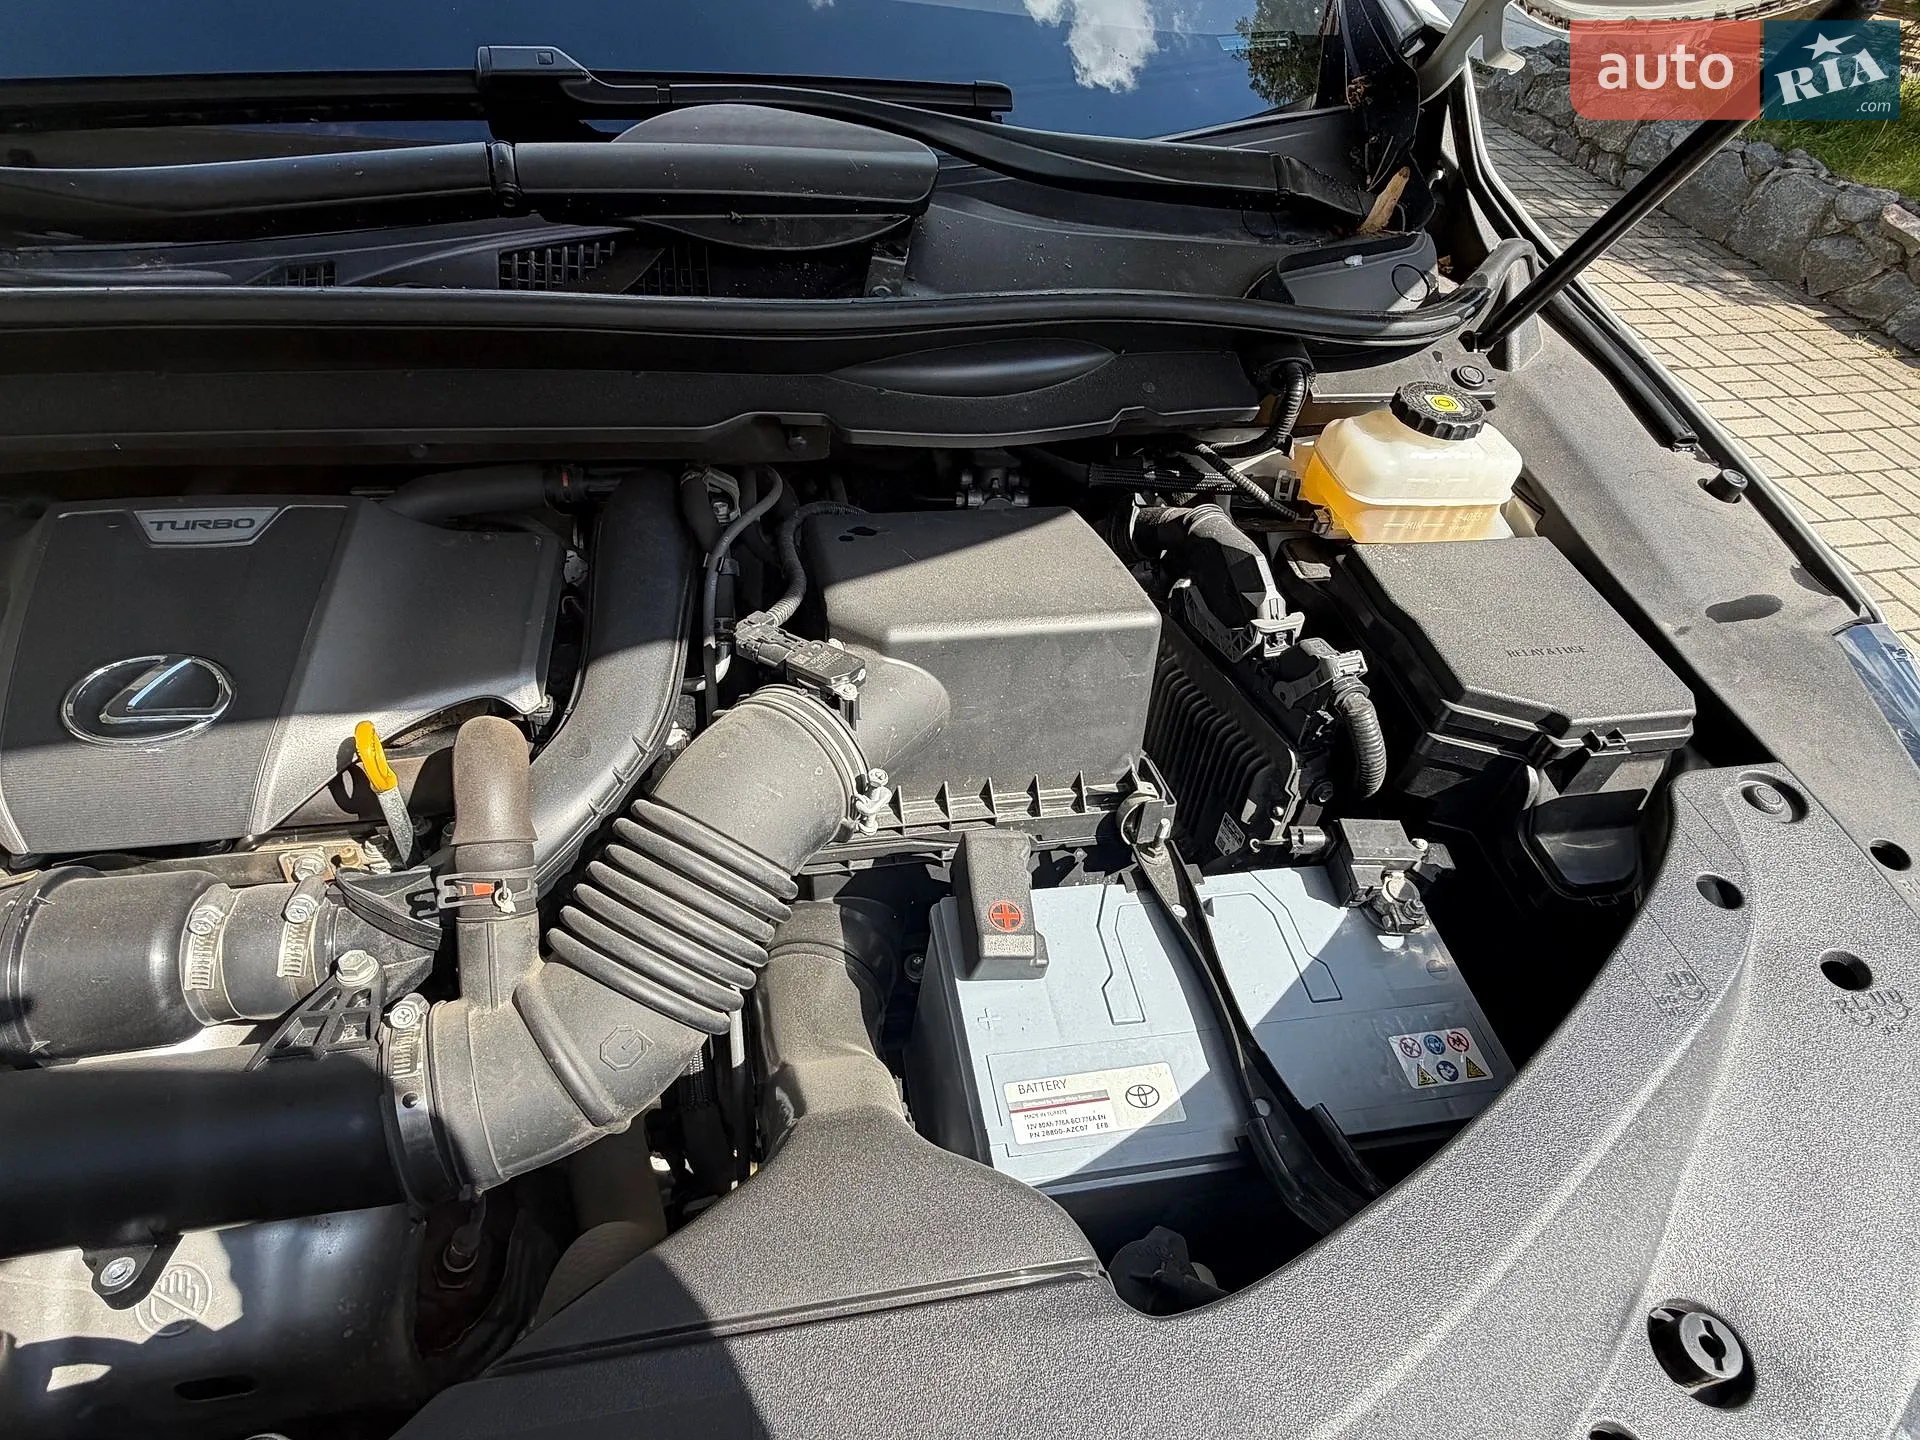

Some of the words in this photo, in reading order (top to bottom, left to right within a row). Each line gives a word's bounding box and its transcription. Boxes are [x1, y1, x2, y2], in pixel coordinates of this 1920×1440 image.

[148, 517, 256, 531] TURBO
[1017, 1078, 1067, 1095] BATTERY
[1029, 1131, 1041, 1139] PN
